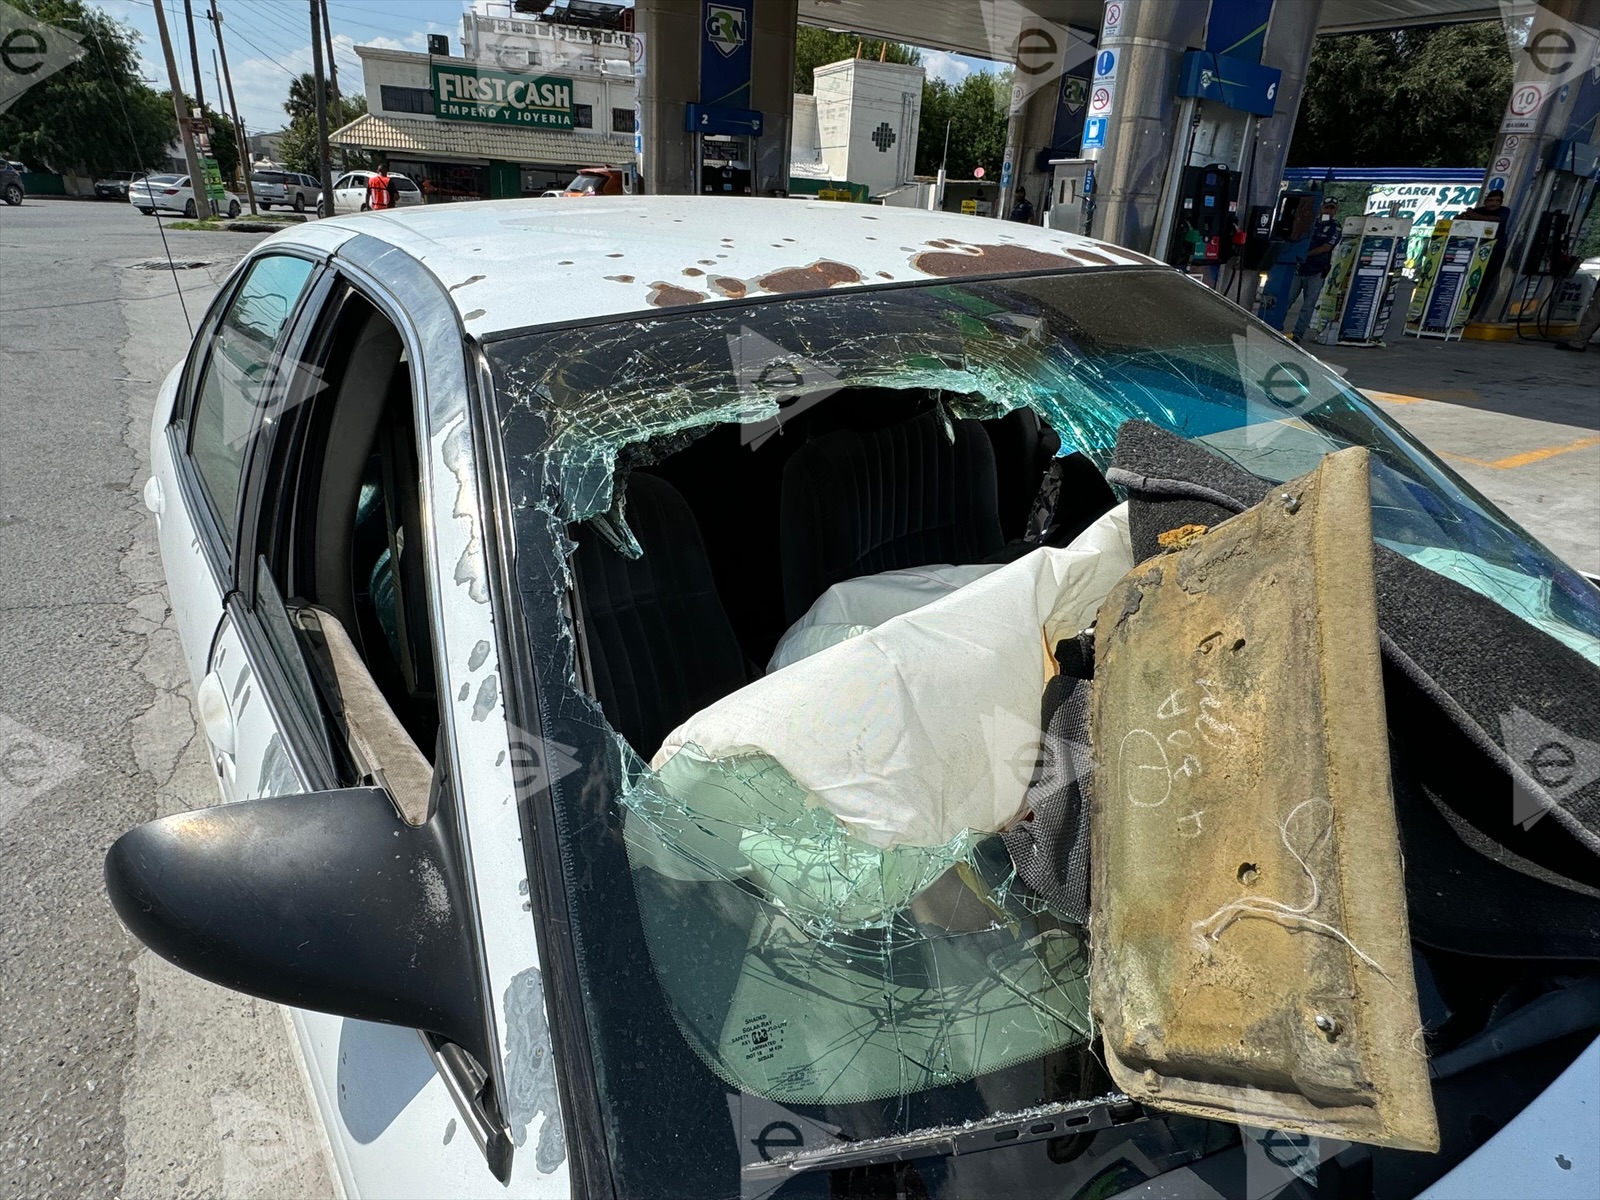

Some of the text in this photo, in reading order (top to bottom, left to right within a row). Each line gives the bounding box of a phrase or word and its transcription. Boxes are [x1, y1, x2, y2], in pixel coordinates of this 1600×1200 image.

[706, 11, 747, 43] GRN
[438, 72, 570, 109] FIRSTCASH
[1266, 82, 1276, 101] 6
[1518, 91, 1536, 105] 10
[440, 103, 571, 125] EMPEÑO Y JOYERIA
[701, 113, 709, 125] 2
[1397, 186, 1436, 196] CARGA
[1369, 200, 1377, 210] Y
